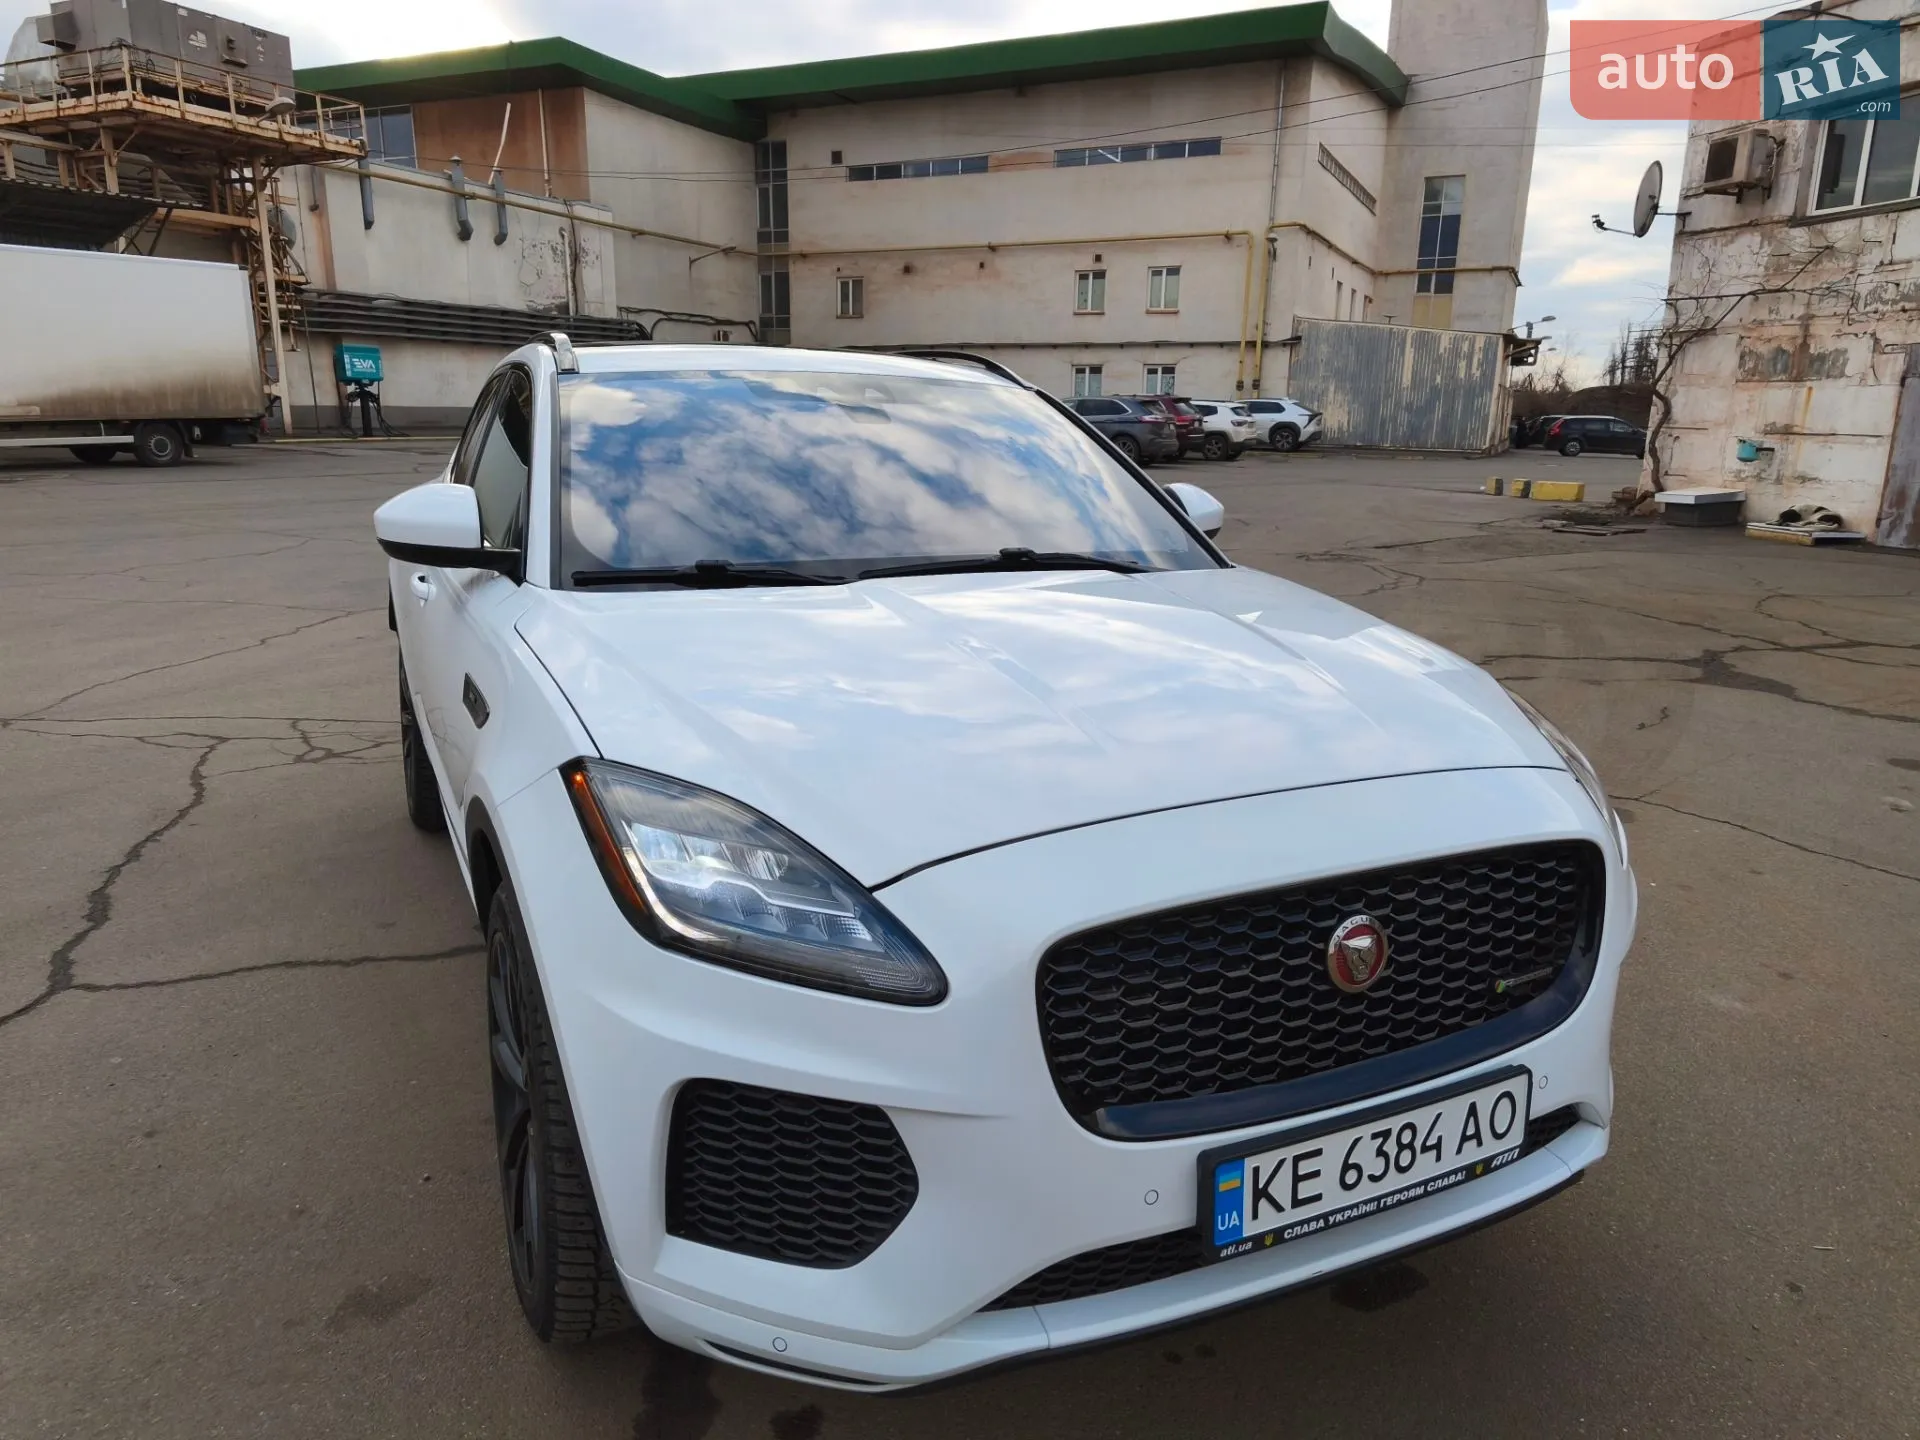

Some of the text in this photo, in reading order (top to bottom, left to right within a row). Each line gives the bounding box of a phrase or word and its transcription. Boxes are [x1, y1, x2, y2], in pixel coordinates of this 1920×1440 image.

[351, 358, 376, 369] EVA
[1251, 1090, 1518, 1221] KE 6384 AO
[1283, 1218, 1325, 1240] СЛАВА
[1379, 1185, 1425, 1209] ГЕРОЯМ
[1426, 1170, 1467, 1192] СЛАВА!
[1217, 1210, 1240, 1231] UA
[1219, 1241, 1253, 1257] atl.ua
